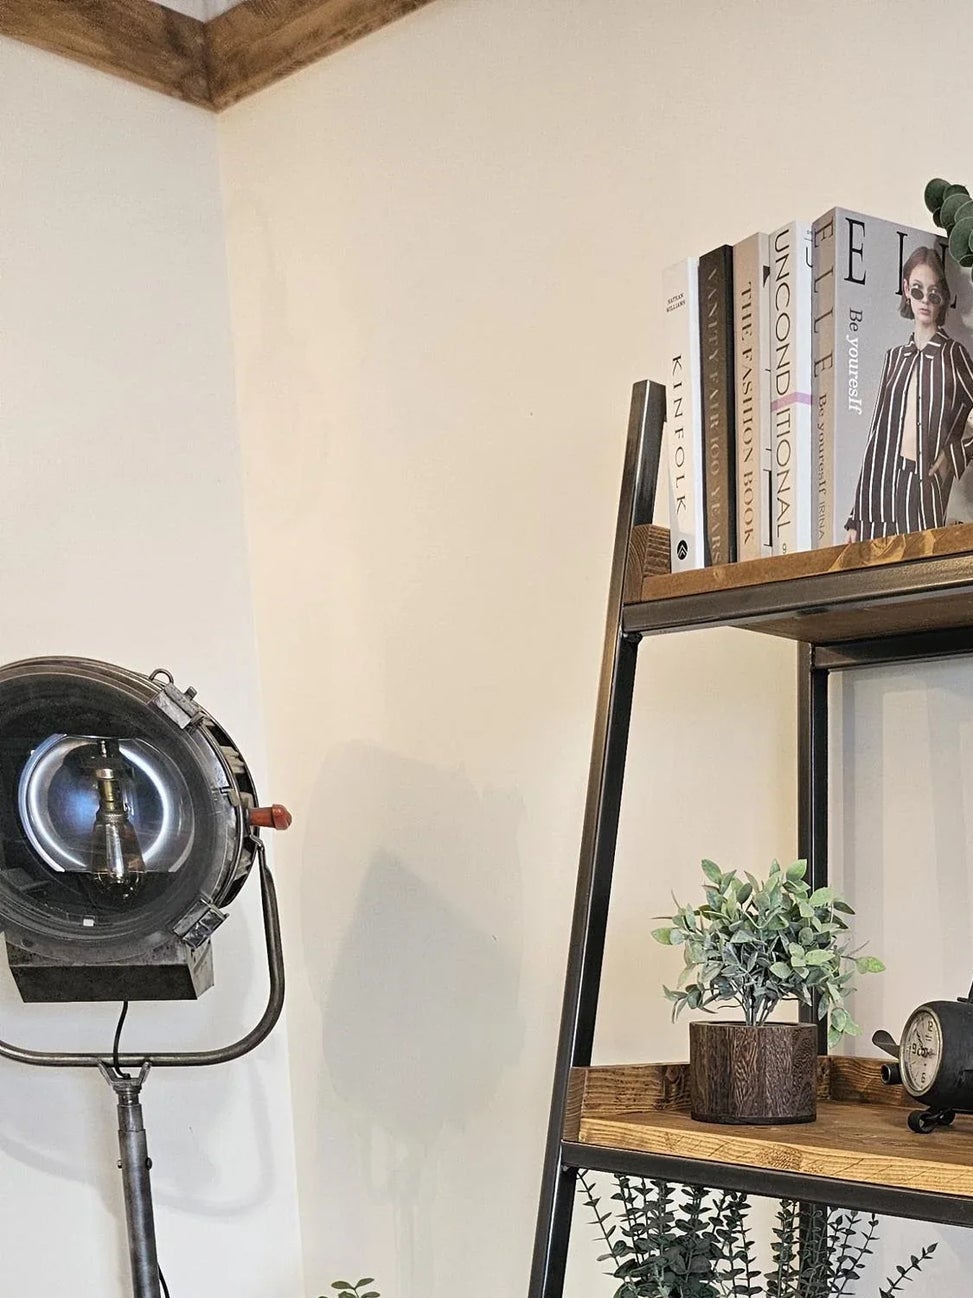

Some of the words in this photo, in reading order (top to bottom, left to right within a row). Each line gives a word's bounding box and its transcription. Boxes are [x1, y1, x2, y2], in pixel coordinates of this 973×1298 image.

[708, 268, 718, 360] VANITY
[741, 281, 752, 341] THE
[813, 217, 834, 378] ELLE
[849, 307, 863, 332] Be
[709, 371, 720, 429] FAIR
[742, 348, 753, 462] FASHION
[774, 228, 791, 538] UNCONDITIONAL
[817, 394, 827, 417] Be
[672, 354, 687, 515] KINFOLK
[711, 486, 721, 563] YEARS
[744, 471, 754, 545] BOOK
